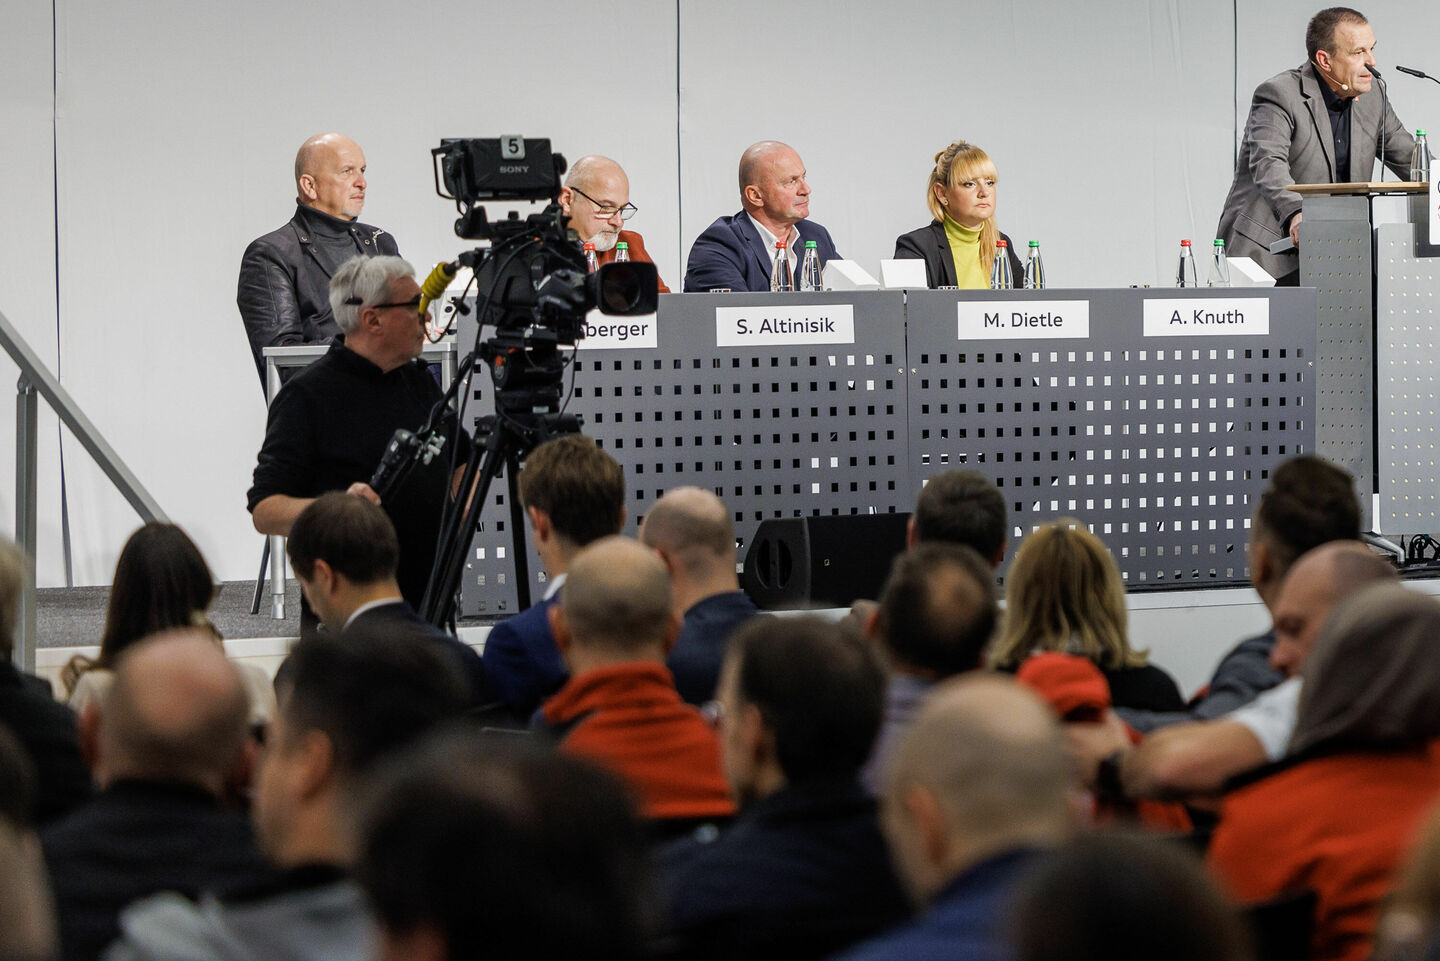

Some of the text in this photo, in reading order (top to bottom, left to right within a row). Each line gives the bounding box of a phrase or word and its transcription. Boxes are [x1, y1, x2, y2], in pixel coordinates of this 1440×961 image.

[509, 138, 519, 154] 5
[499, 165, 529, 174] SONY
[984, 312, 1063, 328] M. Dietle
[1169, 309, 1244, 325] A. Knuth
[586, 322, 648, 340] berger
[736, 317, 835, 335] S. Altinisik
